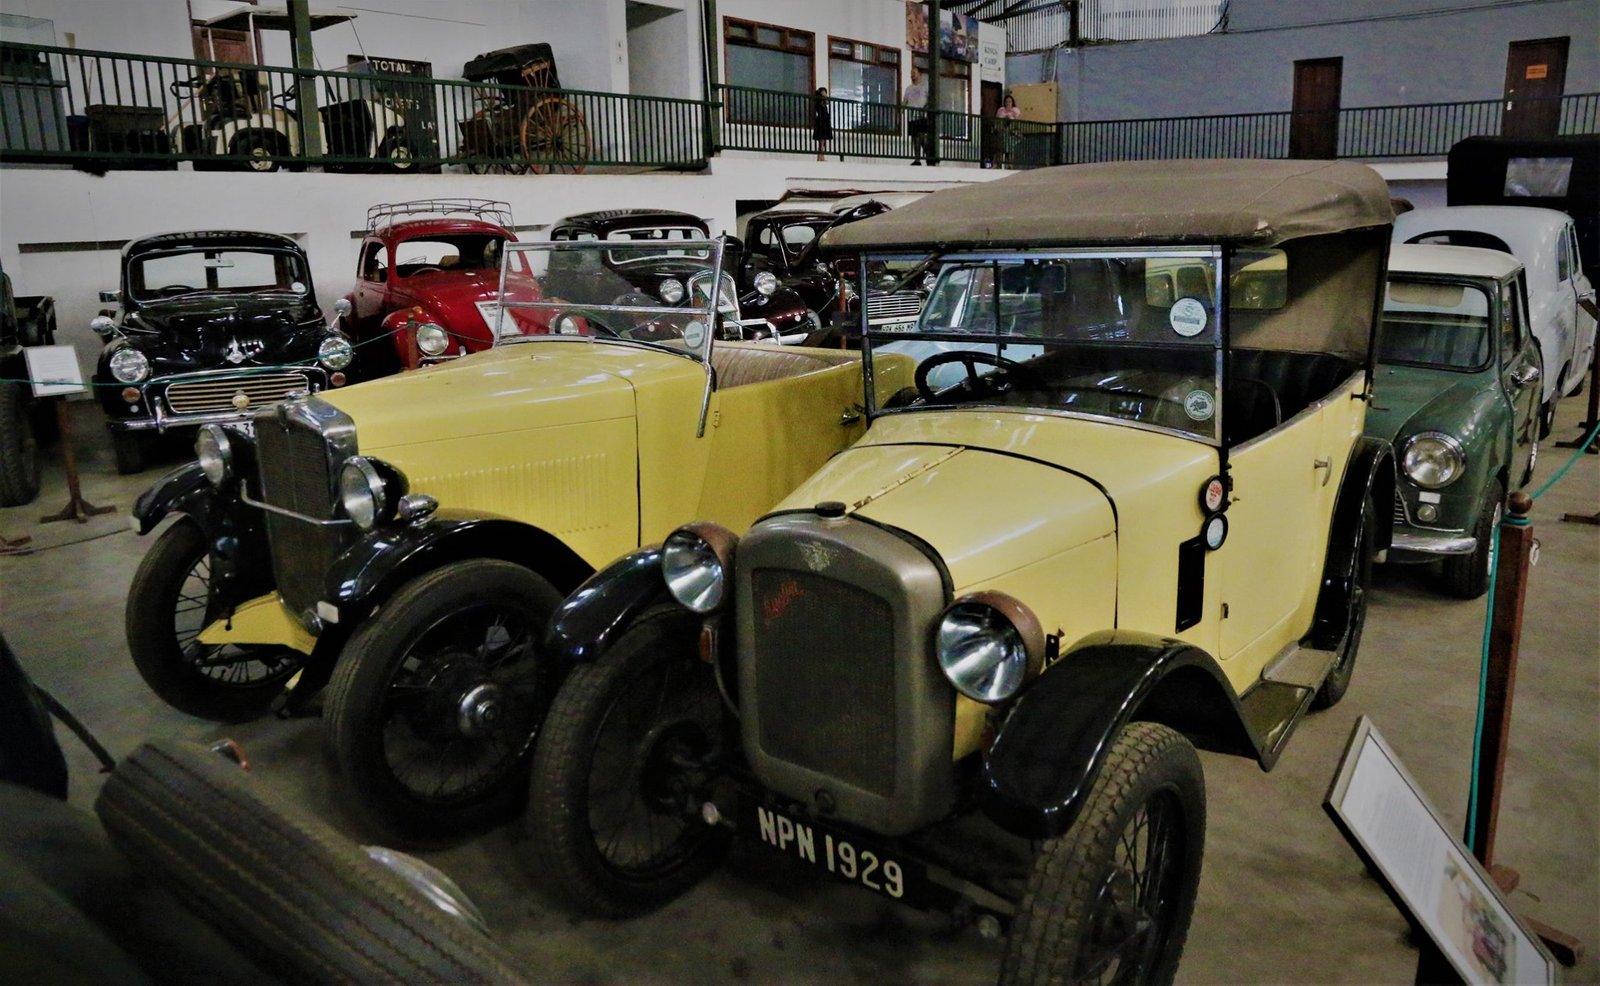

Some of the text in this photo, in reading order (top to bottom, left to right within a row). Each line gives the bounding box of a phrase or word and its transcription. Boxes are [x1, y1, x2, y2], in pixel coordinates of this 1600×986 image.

[372, 60, 411, 74] TOTAL
[758, 806, 904, 898] NPN 1929
